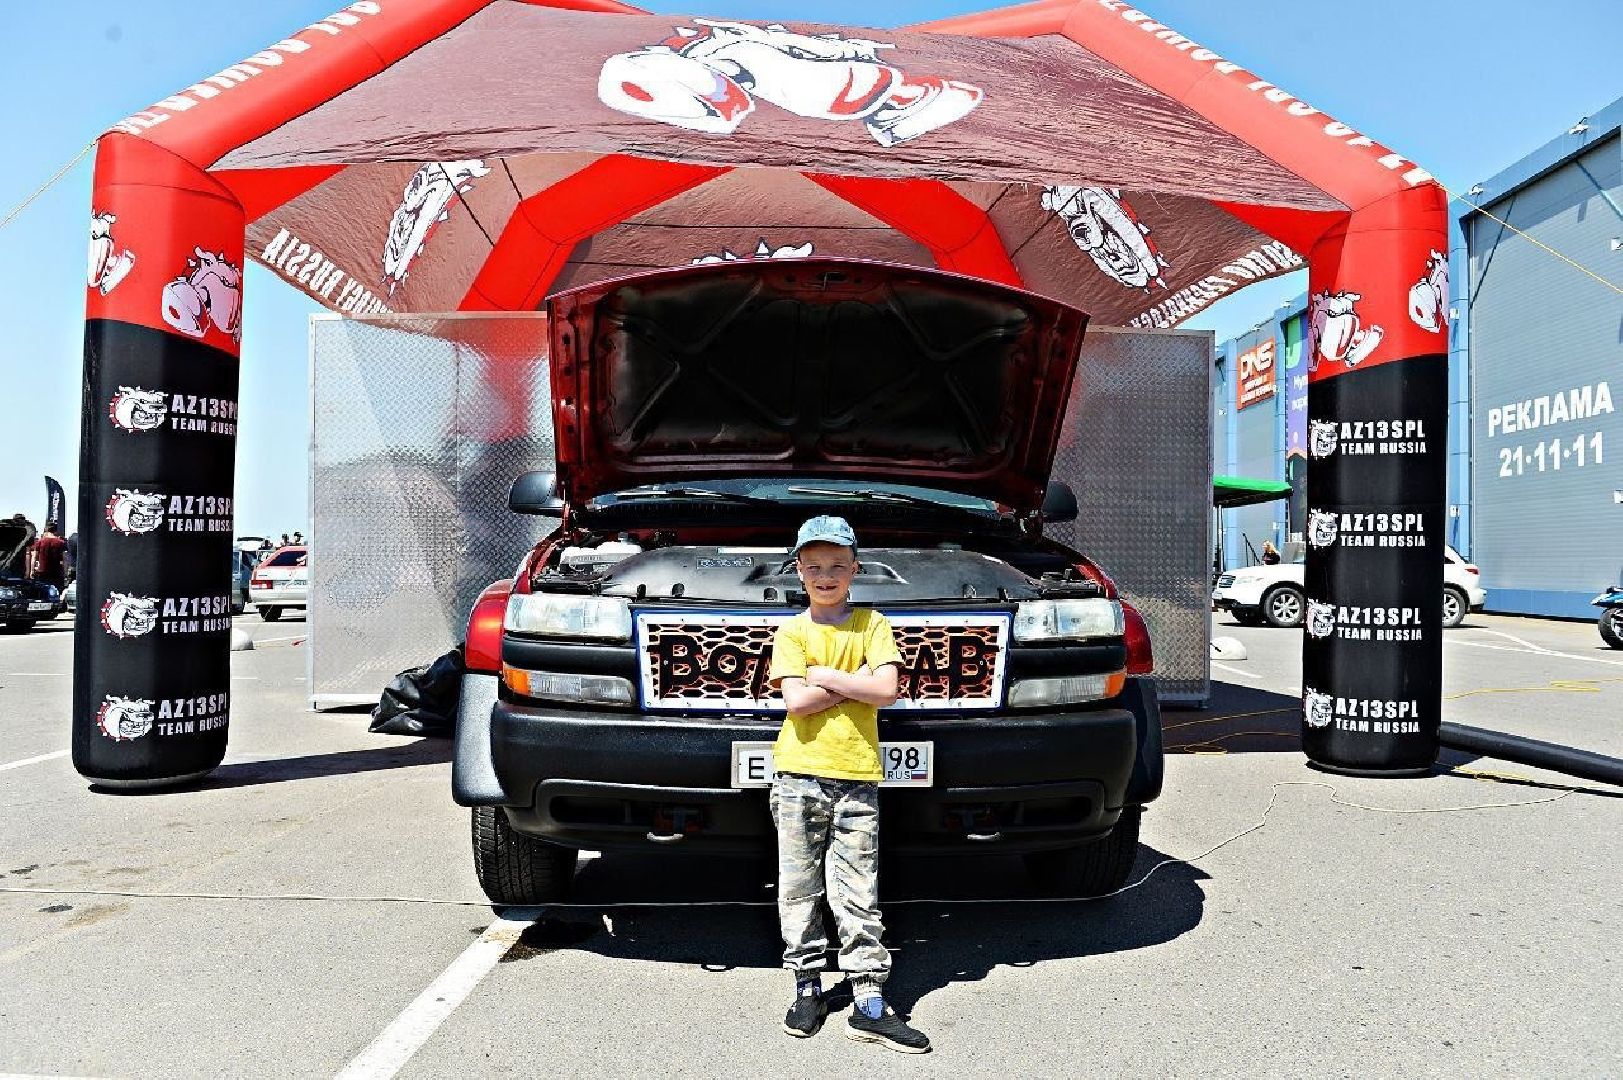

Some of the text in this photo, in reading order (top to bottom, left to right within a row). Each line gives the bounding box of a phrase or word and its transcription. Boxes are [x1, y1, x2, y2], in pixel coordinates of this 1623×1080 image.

[1488, 381, 1615, 438] РЕКЛАМА
[171, 417, 207, 433] TEAM
[1340, 420, 1426, 439] AZ13SPL
[1340, 441, 1427, 455] TEAM RUSSIA
[167, 518, 205, 532] TEAM
[1340, 513, 1424, 532] AZ13SPL
[1340, 535, 1426, 547] TEAM RUSSIA
[1337, 606, 1422, 626] AZ13SPL
[162, 620, 200, 634] TEAM
[1337, 627, 1423, 641] TEAM RUSSIA
[1335, 697, 1419, 719] AZ13SPL
[157, 720, 194, 736] TEAM
[1335, 718, 1421, 733] TEAM RUSSIA
[889, 747, 920, 770] 98
[887, 770, 911, 780] RUS
